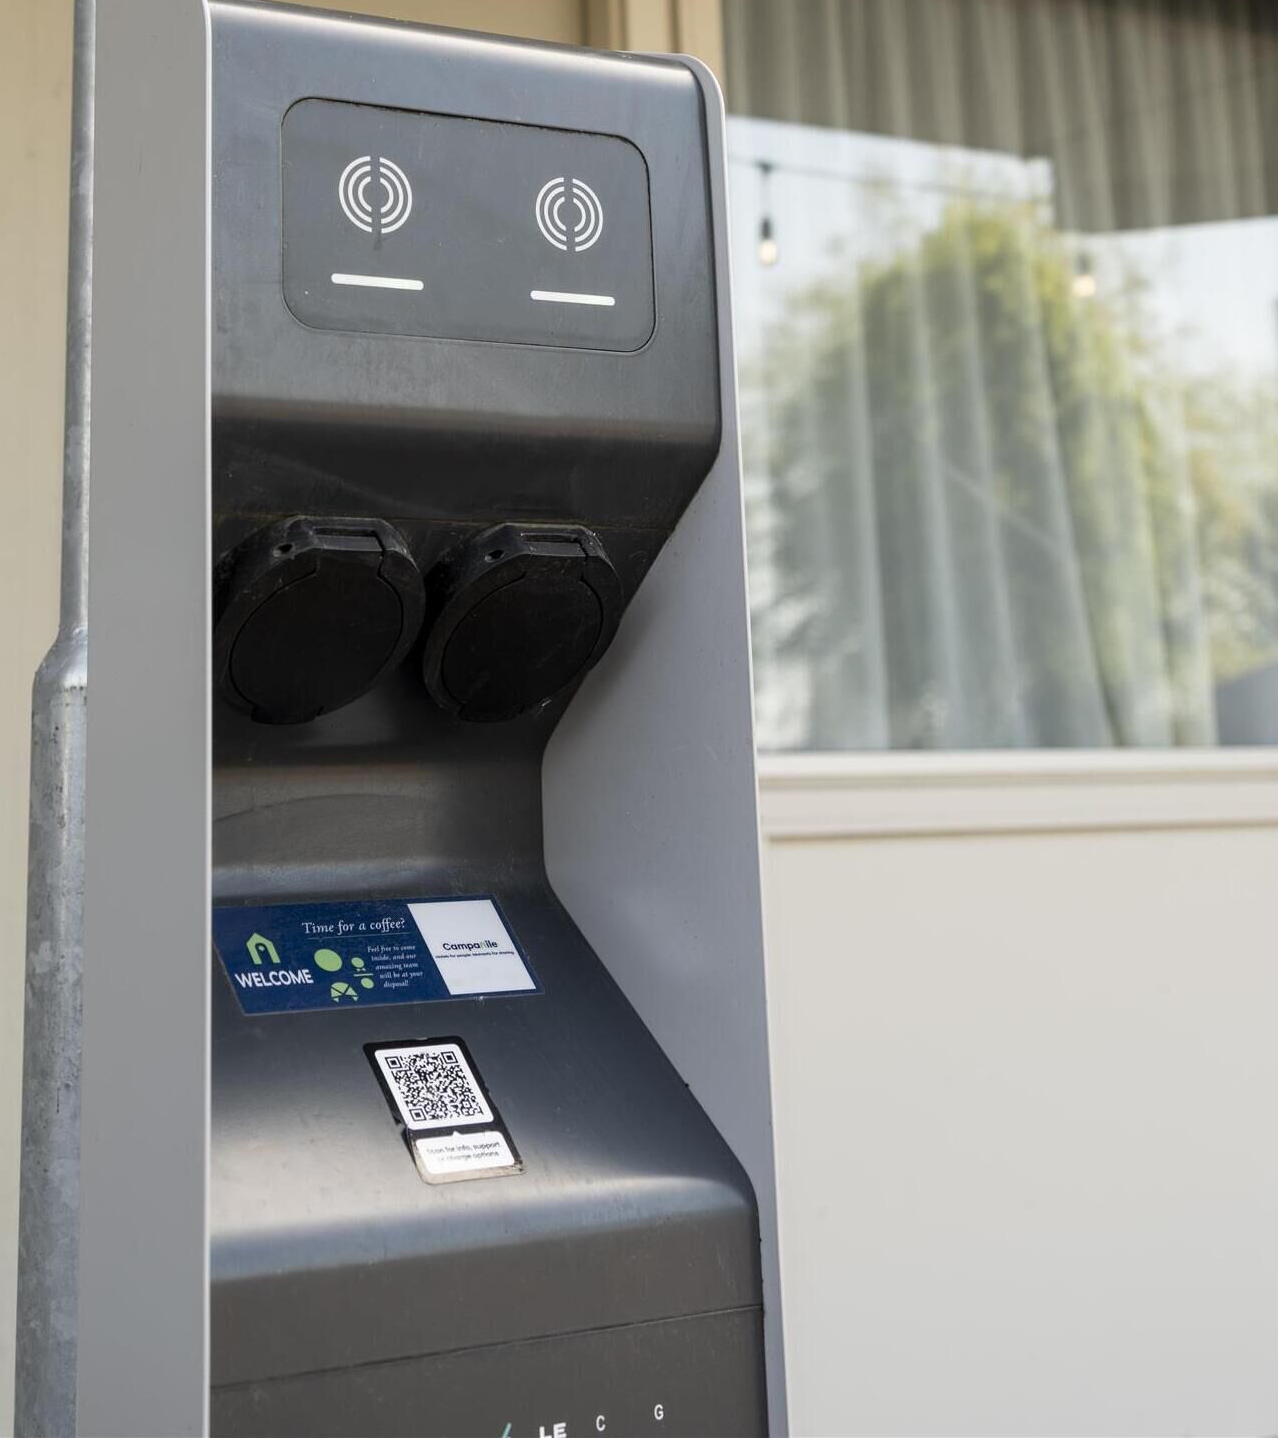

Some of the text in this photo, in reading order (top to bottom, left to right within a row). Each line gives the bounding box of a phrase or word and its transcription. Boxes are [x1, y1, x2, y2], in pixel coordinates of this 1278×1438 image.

[301, 917, 405, 935] Time for a coffee?
[234, 969, 314, 988] WELCOME
[654, 1404, 664, 1420] G
[596, 1415, 606, 1431] C
